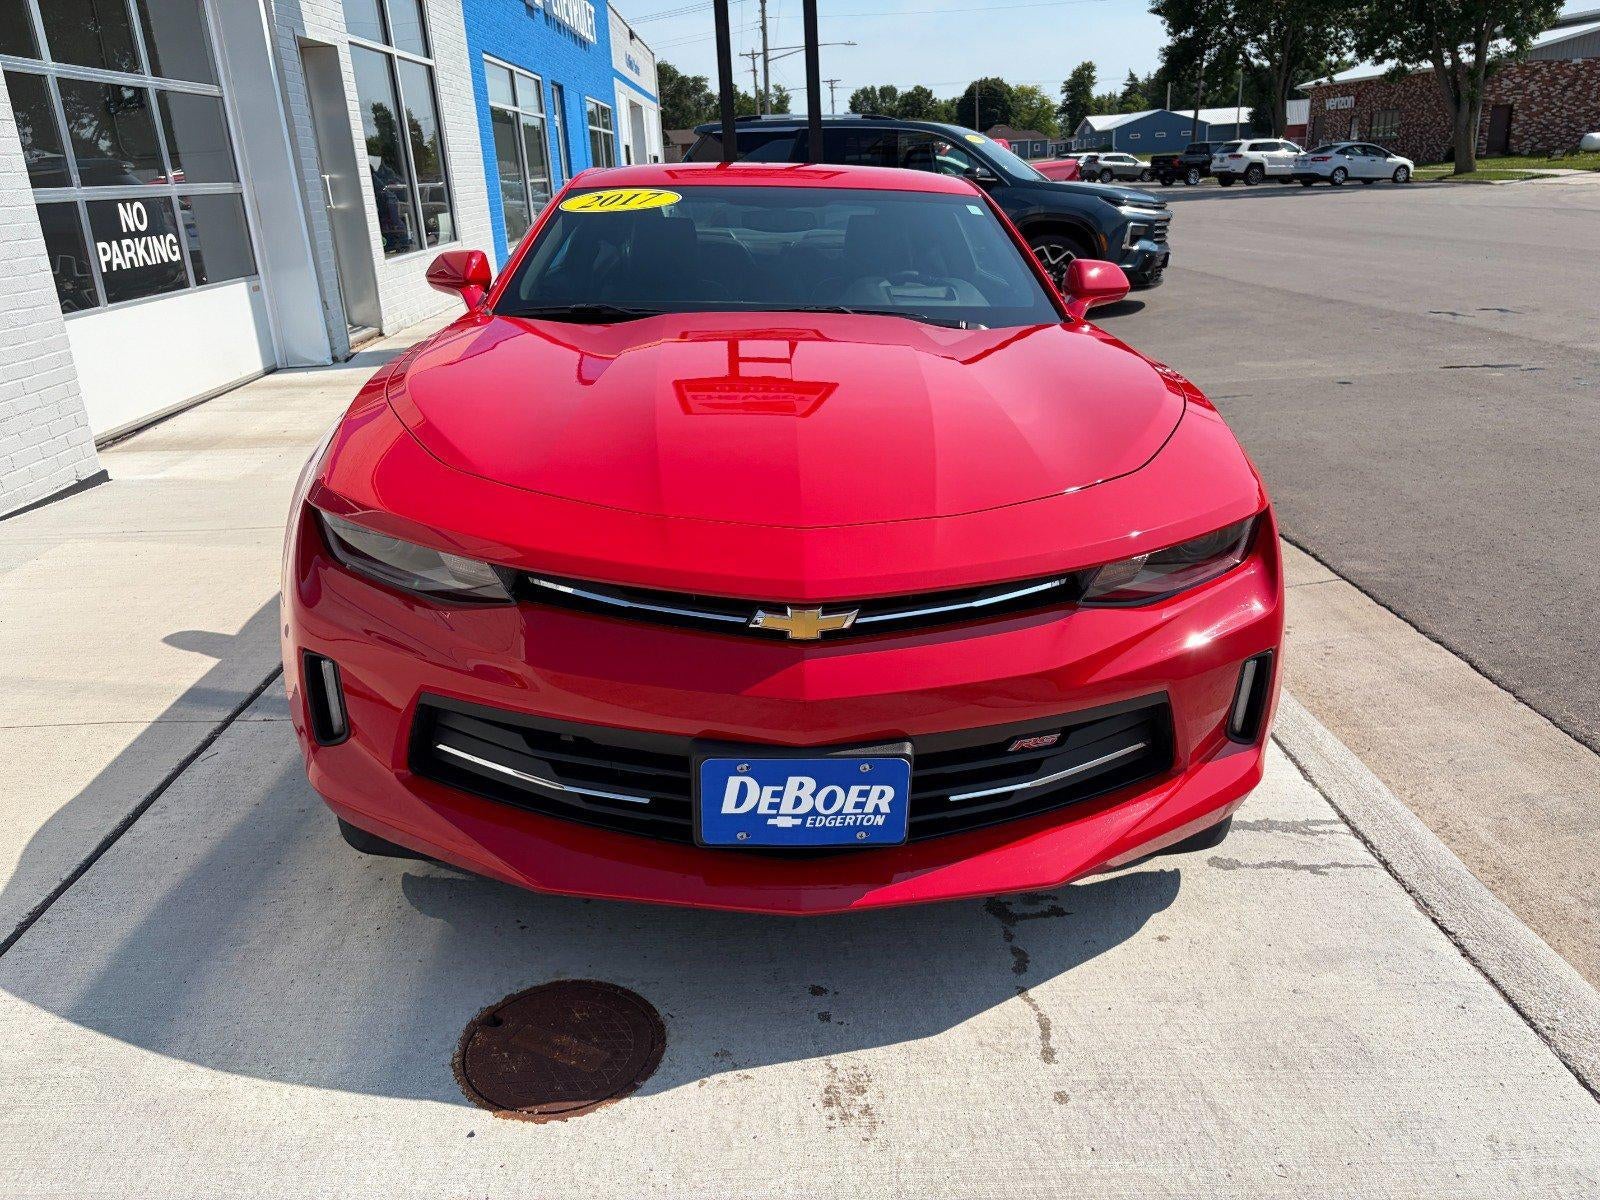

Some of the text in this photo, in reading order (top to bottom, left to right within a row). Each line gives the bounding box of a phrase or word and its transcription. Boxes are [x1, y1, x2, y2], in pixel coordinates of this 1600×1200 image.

[1325, 95, 1355, 110] verizon
[576, 193, 664, 209] 2017
[118, 201, 148, 232] NO
[96, 233, 181, 273] PARKING
[806, 815, 885, 828] EDGERTON
